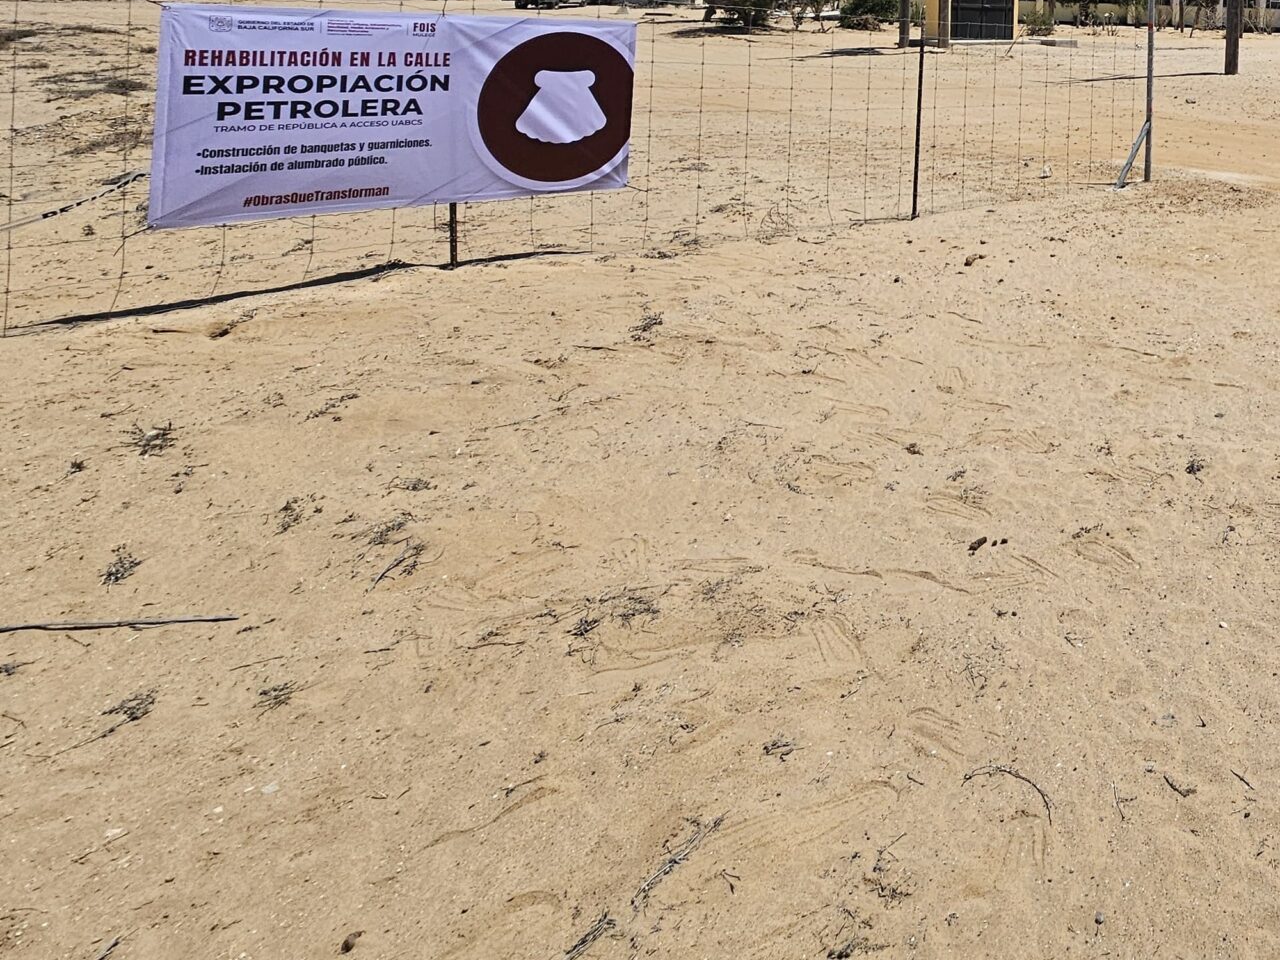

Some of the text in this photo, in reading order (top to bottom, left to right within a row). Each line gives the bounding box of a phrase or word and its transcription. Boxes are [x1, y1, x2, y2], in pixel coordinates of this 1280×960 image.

[413, 22, 436, 33] FOIS
[184, 48, 451, 67] REHABILITACIÓN EN LA CALLE
[182, 70, 450, 95] EXPROPIACIÓN
[216, 98, 424, 121] PETROLERA
[214, 124, 256, 133] TRAMO
[259, 124, 275, 132] DE
[278, 121, 338, 131] REPÚBLICA
[349, 120, 389, 128] ACCESO
[391, 119, 423, 127] UABCS
[284, 144, 297, 154] de
[300, 142, 356, 154] banquetas
[358, 142, 365, 152] y
[367, 138, 432, 151] guarniciones.
[270, 161, 284, 171] de
[287, 158, 345, 170] alumbrado
[348, 155, 388, 167] público.
[243, 186, 390, 207] #ObrasQueTransforman
